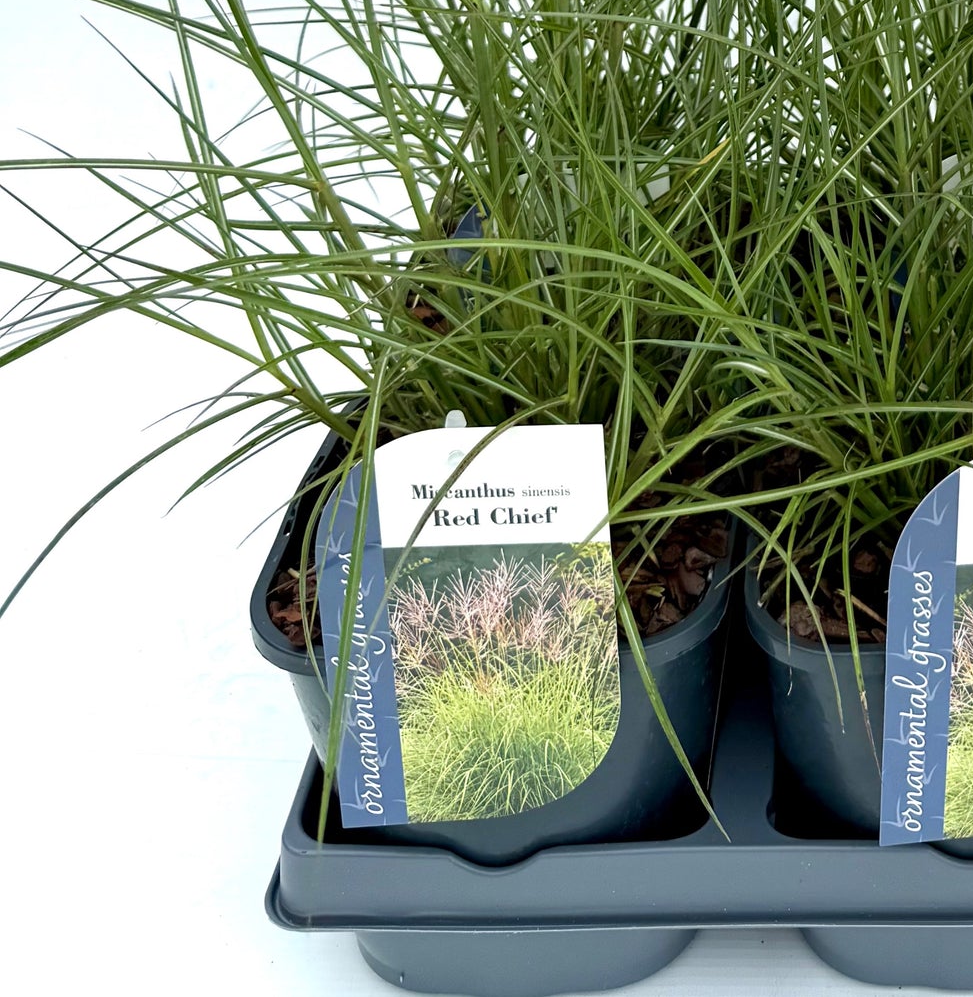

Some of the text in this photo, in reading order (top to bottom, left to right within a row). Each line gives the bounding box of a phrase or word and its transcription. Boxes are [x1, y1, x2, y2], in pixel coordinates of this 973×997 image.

[521, 485, 571, 497] sinensis
[489, 505, 558, 525] Chief'
[892, 570, 947, 833] ornamental grasses
